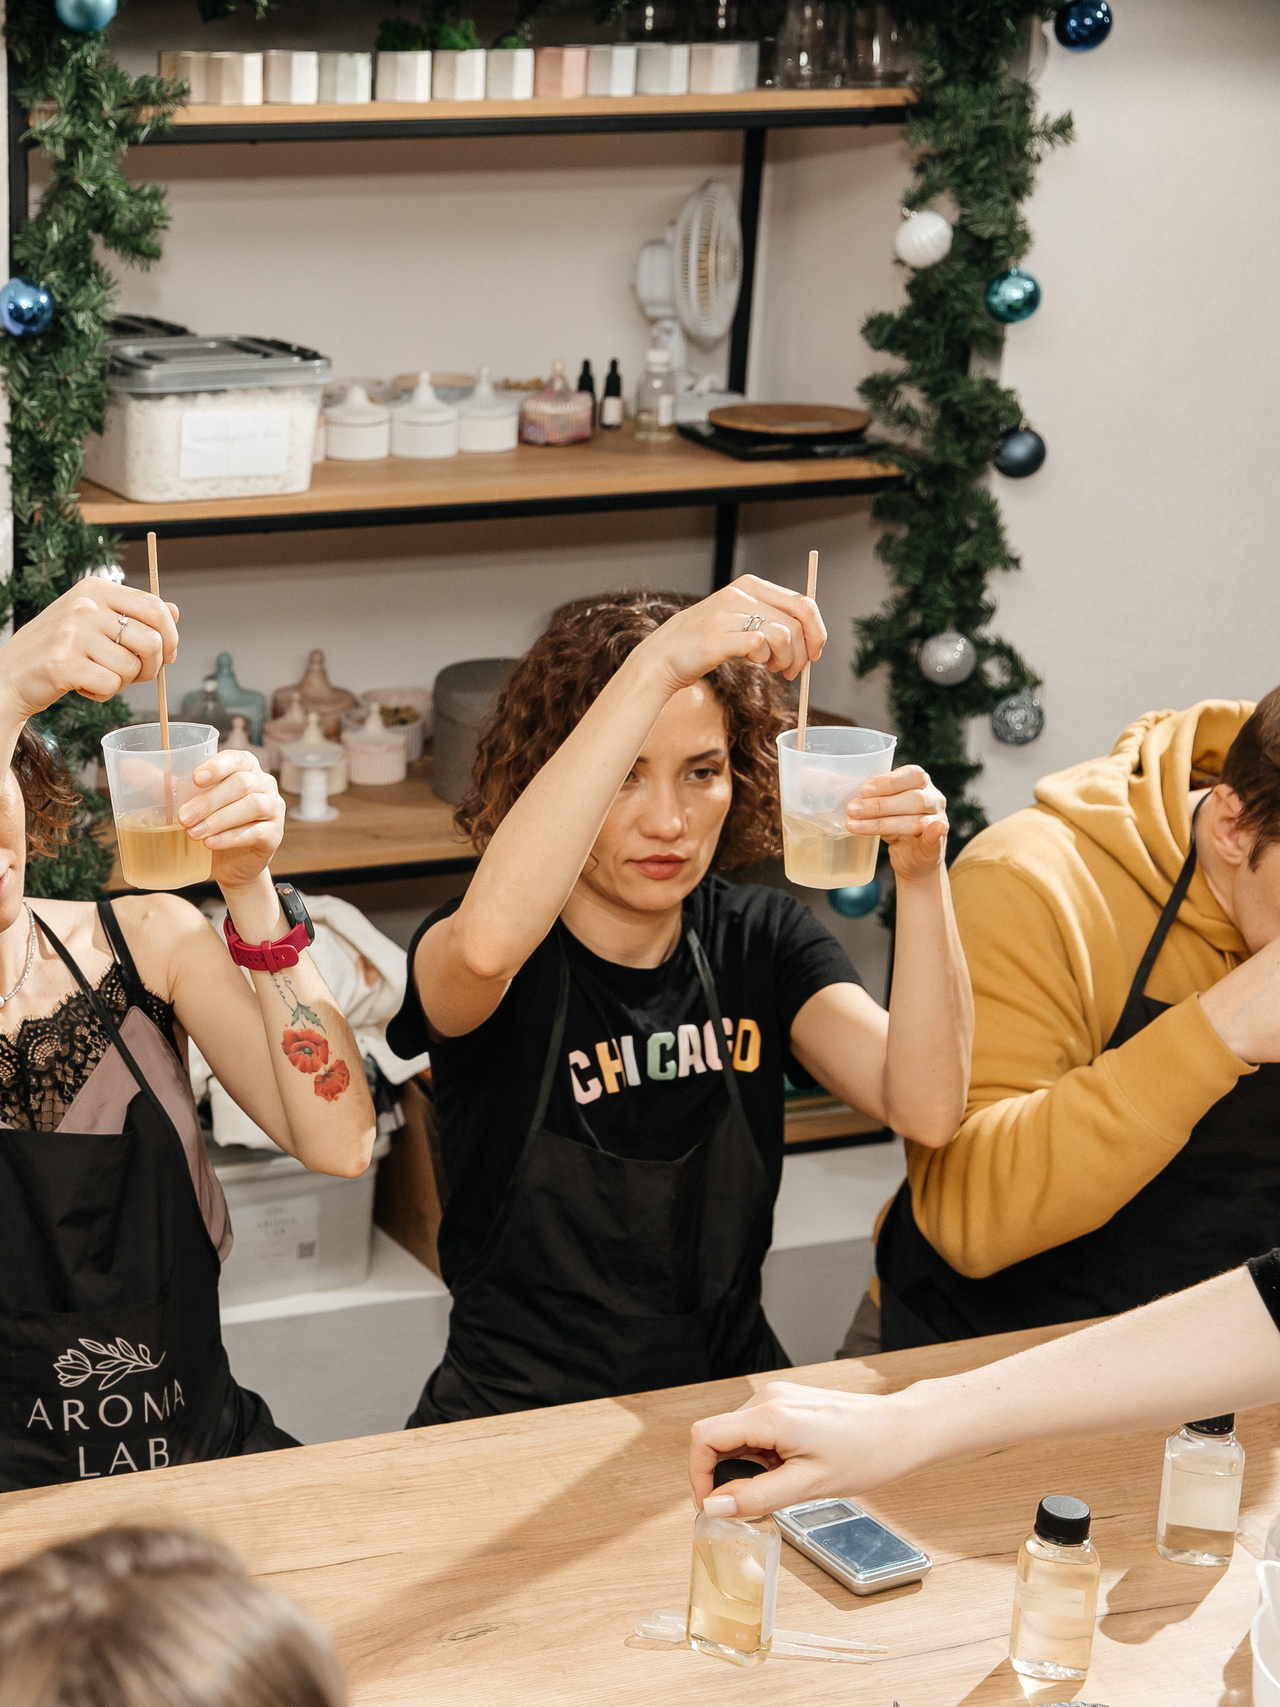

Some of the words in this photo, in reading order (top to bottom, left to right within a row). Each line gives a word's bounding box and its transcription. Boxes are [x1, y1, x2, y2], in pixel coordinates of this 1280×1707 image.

[568, 1017, 762, 1105] CHICAGO
[26, 1378, 185, 1432] AROMA
[78, 1437, 170, 1478] LAB
